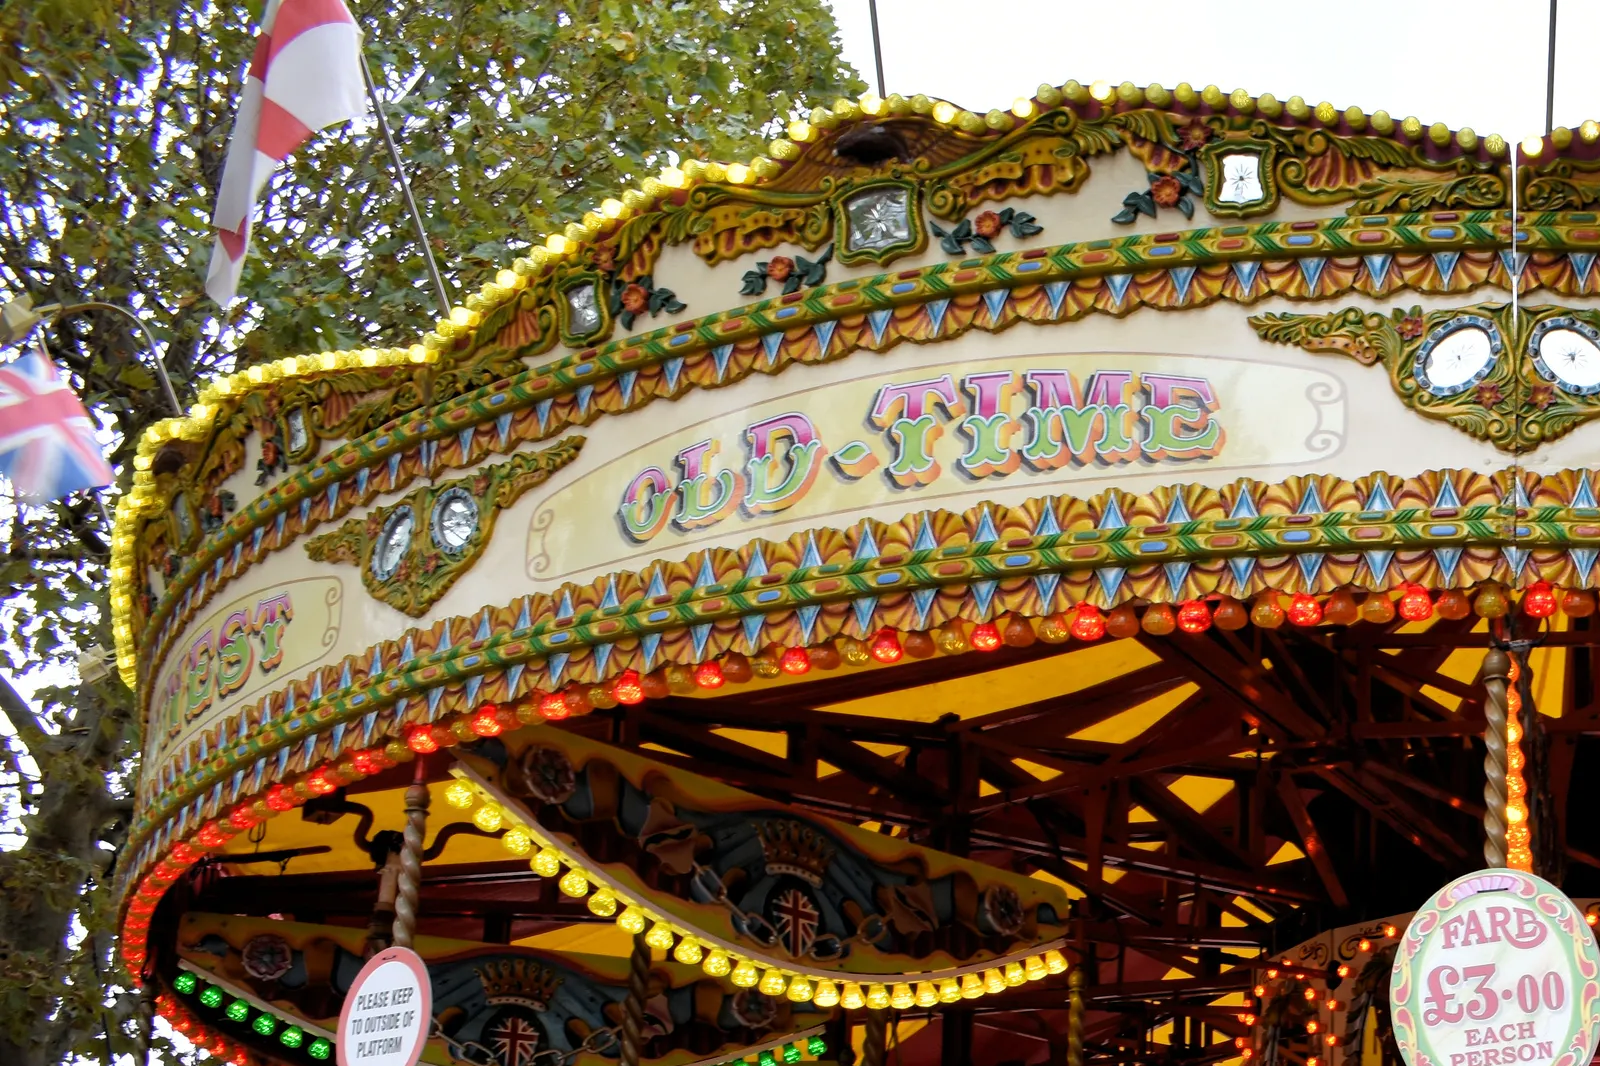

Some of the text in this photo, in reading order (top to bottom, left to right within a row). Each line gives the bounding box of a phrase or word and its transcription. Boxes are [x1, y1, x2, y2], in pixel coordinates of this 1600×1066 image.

[1439, 906, 1548, 950] FARE
[356, 987, 414, 1012] PLEASE KEEP
[351, 1010, 415, 1035] TO OUTSIDE OF
[1464, 1021, 1536, 1047] EACH
[356, 1036, 403, 1059] PLATFORM
